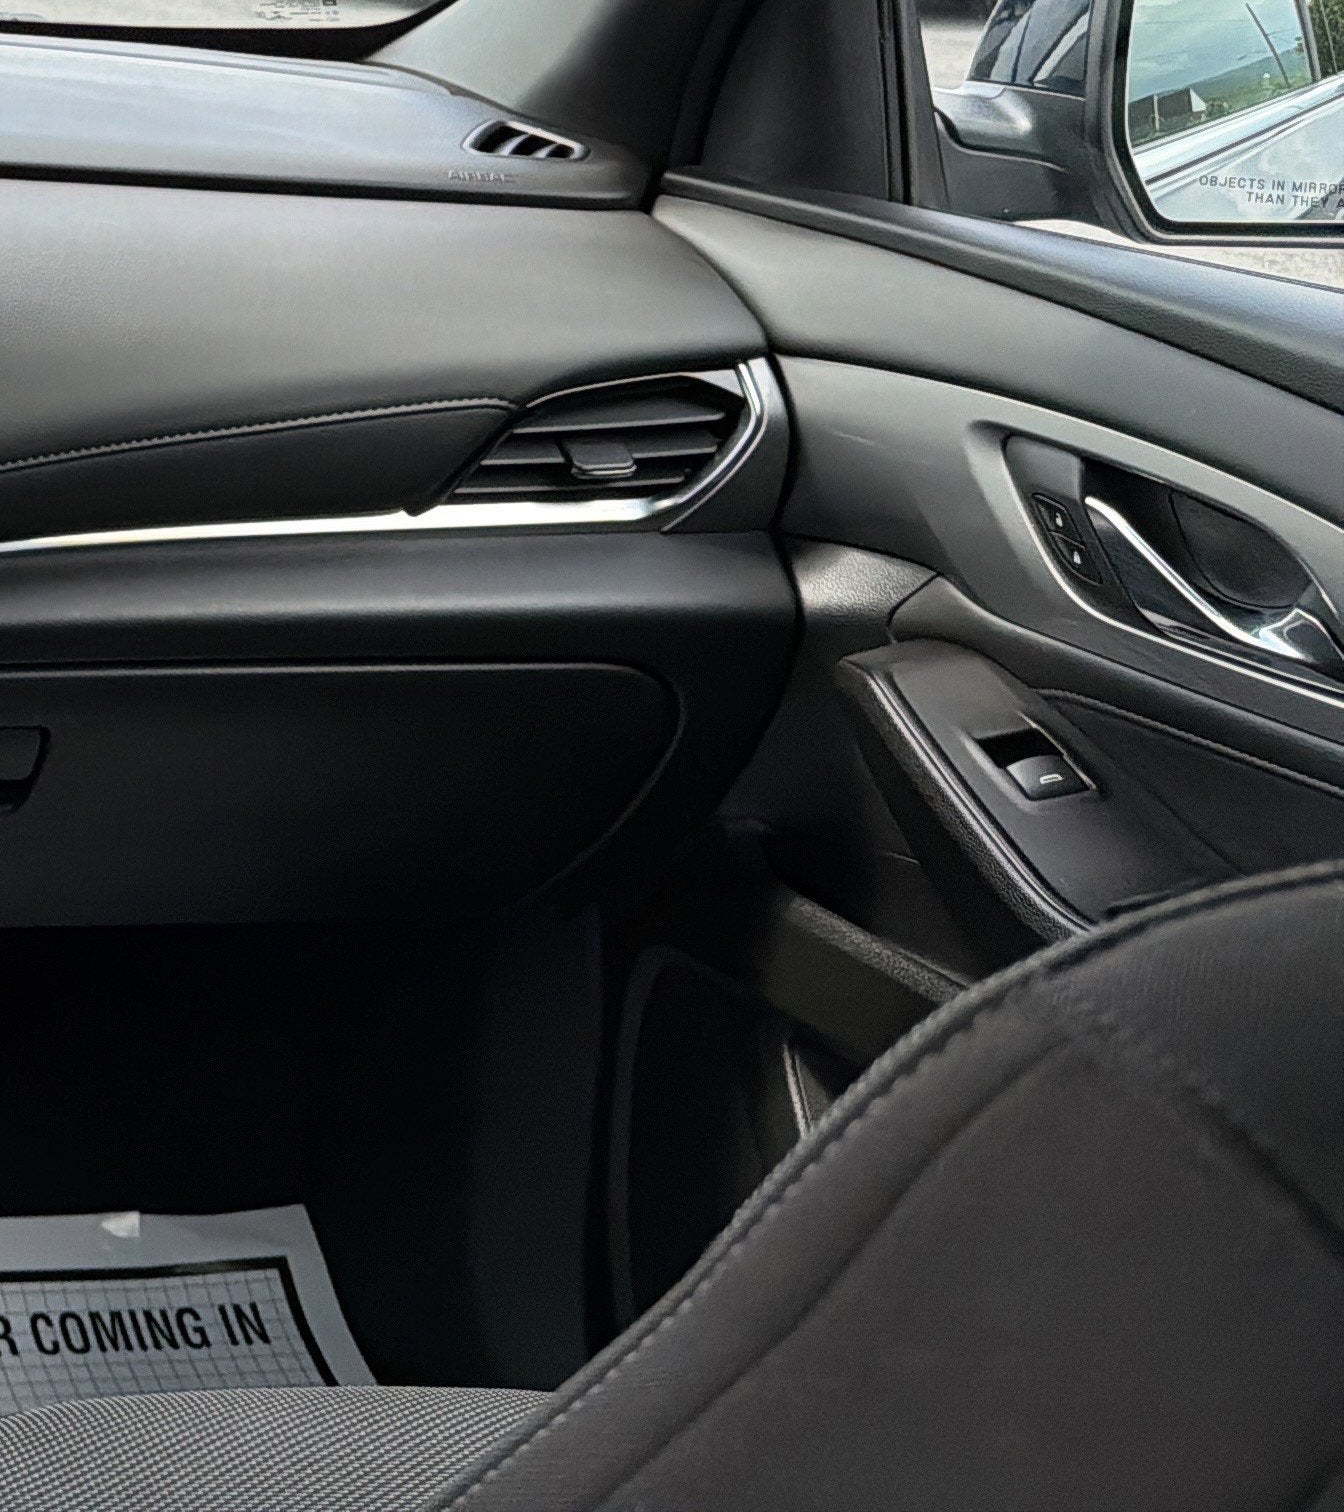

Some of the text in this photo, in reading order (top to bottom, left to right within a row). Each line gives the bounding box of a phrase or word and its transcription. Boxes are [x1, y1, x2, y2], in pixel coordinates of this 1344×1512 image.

[1198, 175, 1266, 190] OBJECTS
[1271, 179, 1286, 192] IN
[1246, 191, 1285, 205] THAN
[1291, 194, 1330, 209] THEY
[29, 1305, 212, 1356] COMING
[218, 1301, 272, 1347] IN
